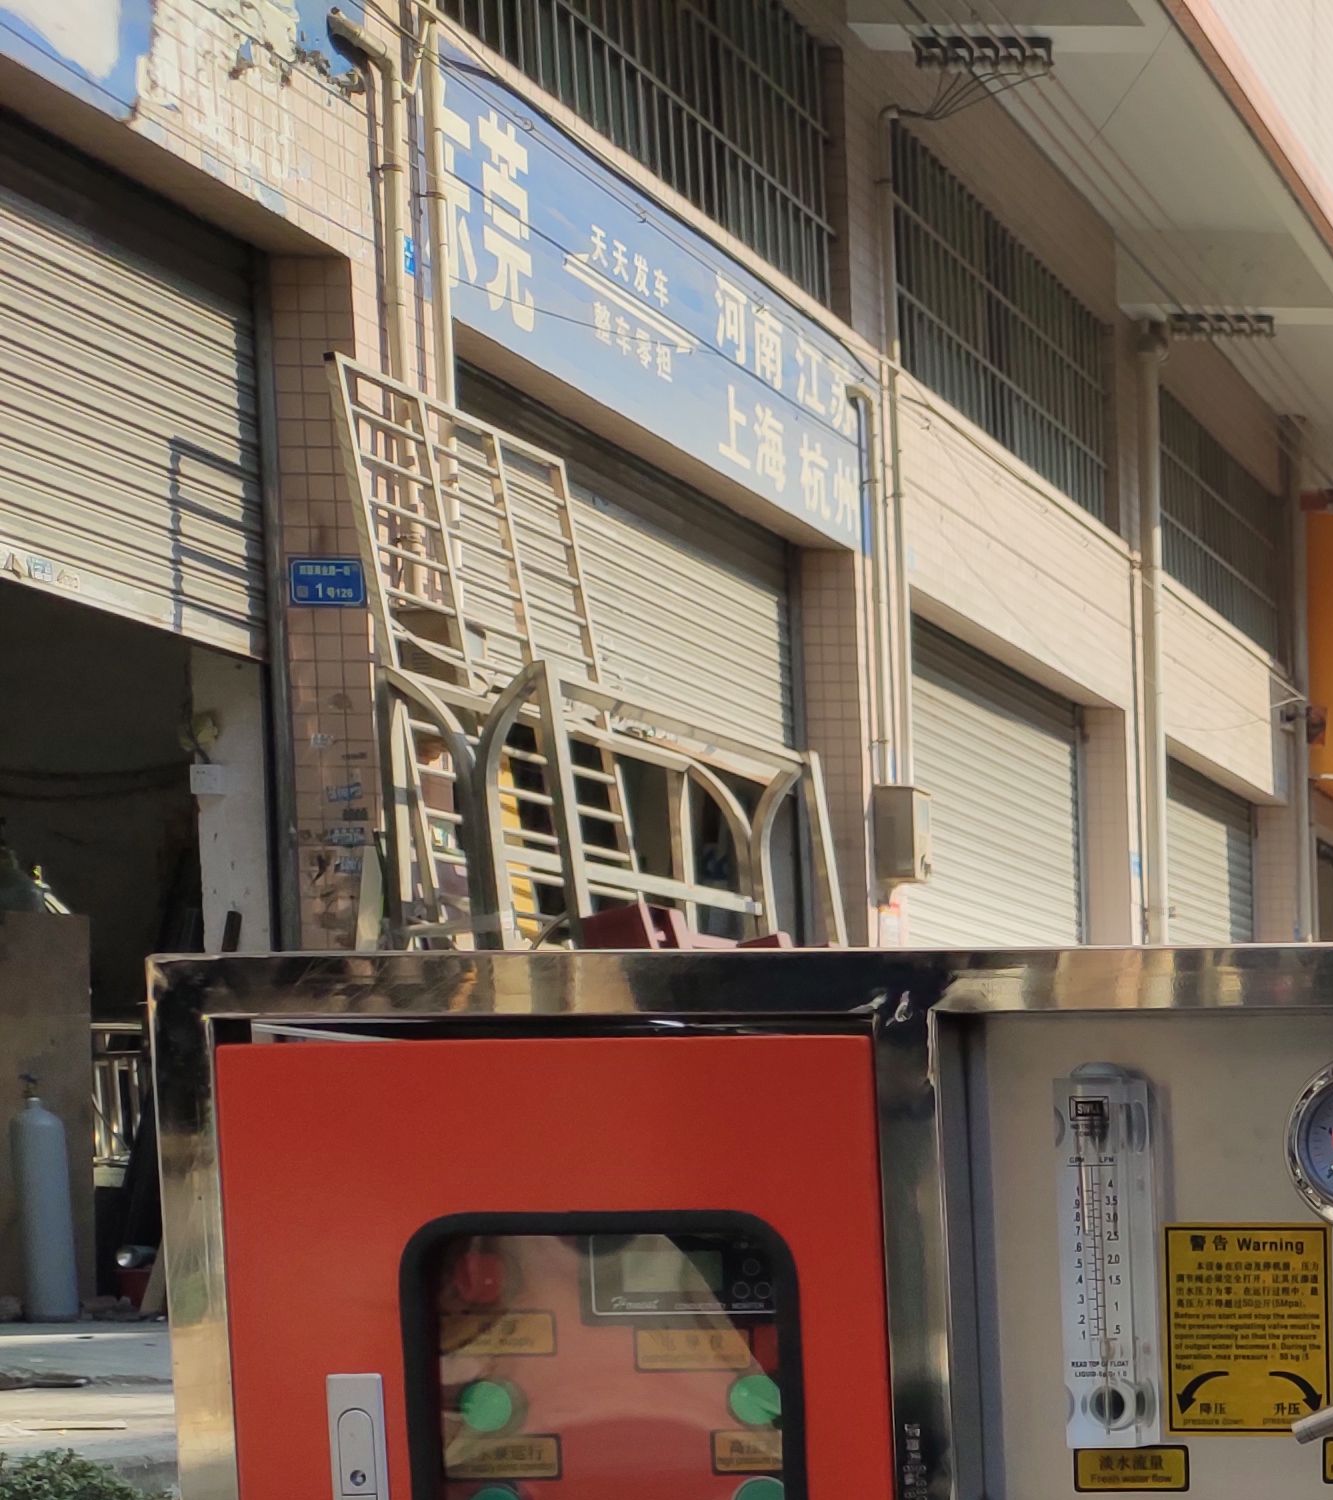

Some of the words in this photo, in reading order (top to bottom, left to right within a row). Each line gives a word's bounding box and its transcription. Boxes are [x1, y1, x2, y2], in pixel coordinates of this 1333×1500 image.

[589, 223, 670, 308] 天天发车
[593, 301, 673, 383] 整车零担
[713, 271, 784, 391] 河南
[795, 341, 858, 437] 江苏
[717, 385, 787, 492] 上海
[798, 433, 860, 540] 杭州
[1237, 1238, 1304, 1254] Warning
[1274, 1402, 1300, 1415] 升压
